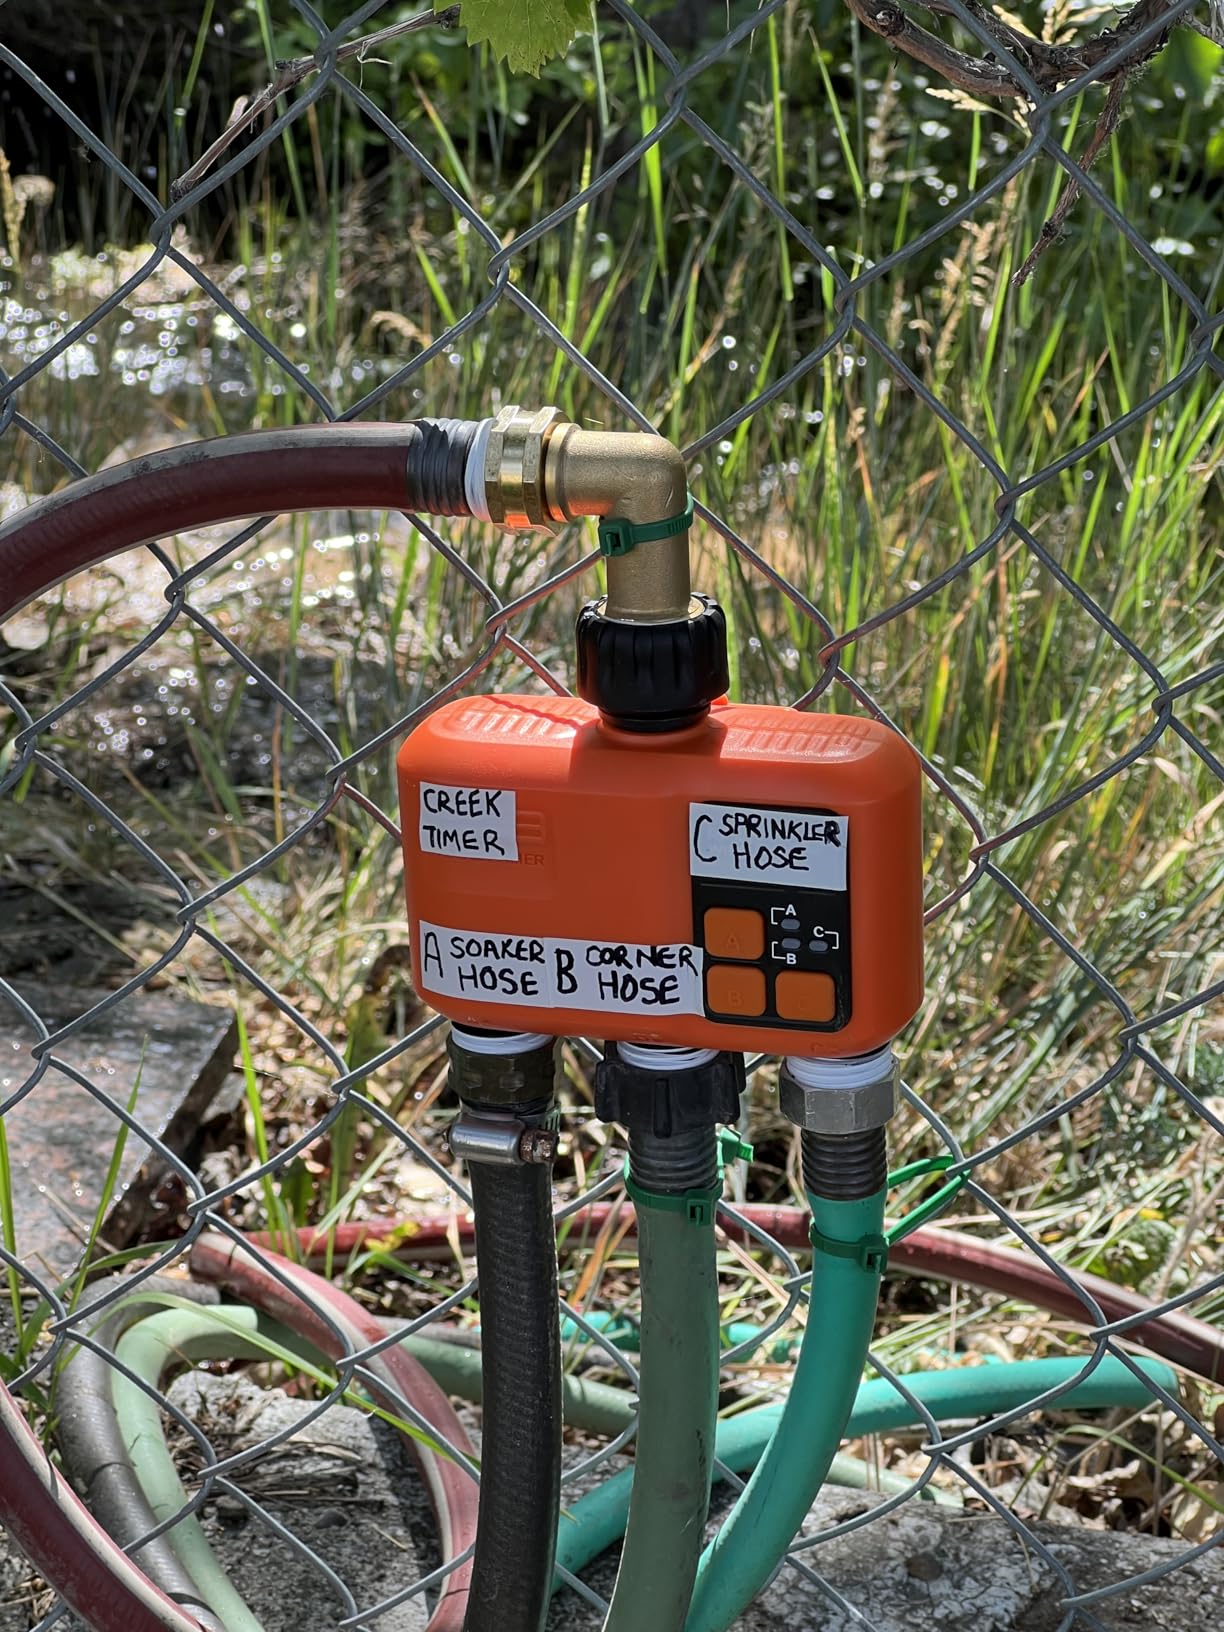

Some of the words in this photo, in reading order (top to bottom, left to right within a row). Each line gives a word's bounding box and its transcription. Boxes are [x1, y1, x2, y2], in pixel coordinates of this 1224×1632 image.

[423, 788, 502, 818] CREEK
[422, 825, 505, 856] TIMER
[693, 814, 717, 863] C
[718, 812, 842, 848] SPRINKLER
[732, 841, 810, 871] HOSE
[785, 904, 797, 916] A
[813, 926, 825, 938] C
[424, 931, 444, 979] A
[449, 936, 546, 964] SOAKER
[554, 947, 578, 994] B
[585, 944, 699, 977] CORNER
[786, 953, 797, 965] B
[458, 963, 539, 996] HOSE
[598, 970, 681, 1005] HOSE
